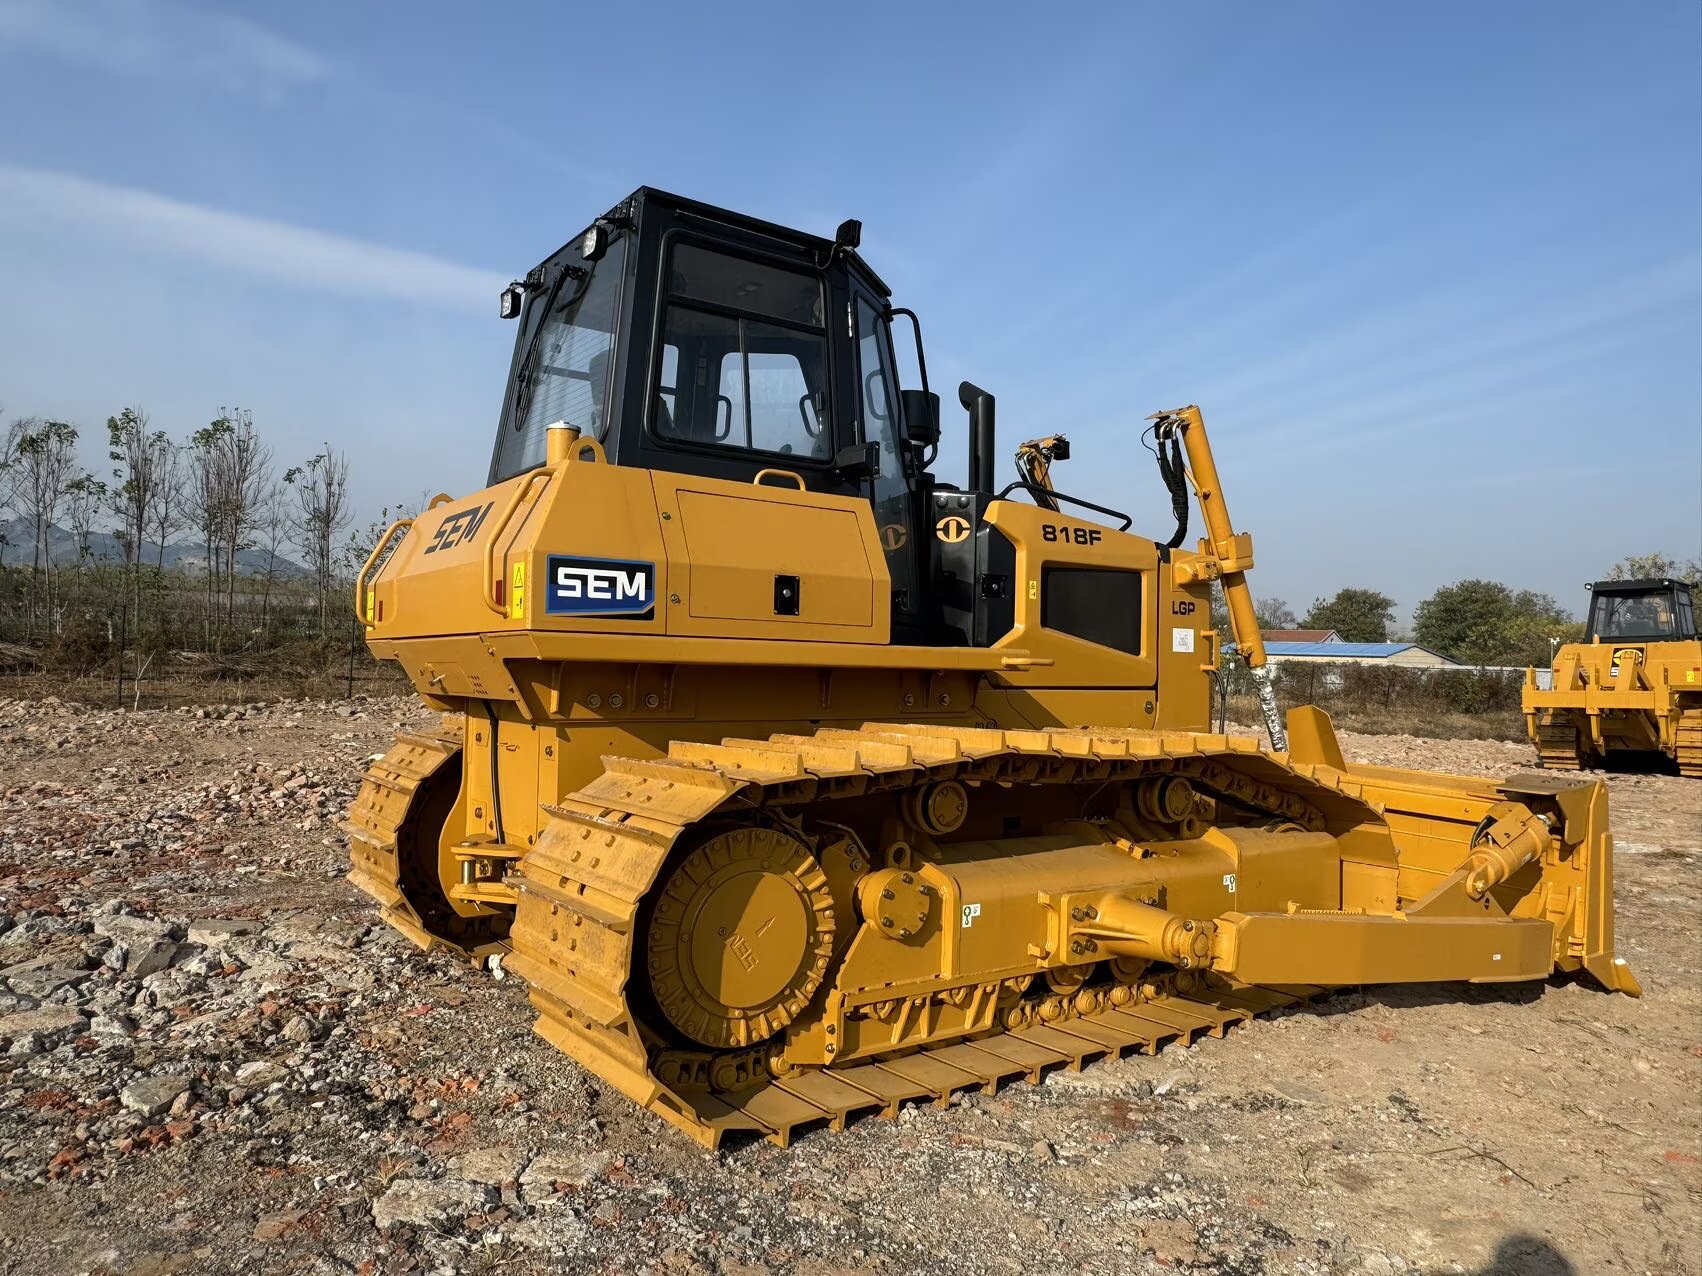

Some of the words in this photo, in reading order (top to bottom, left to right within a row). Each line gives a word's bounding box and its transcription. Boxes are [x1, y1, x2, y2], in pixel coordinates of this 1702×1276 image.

[424, 501, 495, 554] SEM
[1042, 524, 1102, 545] 818F
[557, 567, 646, 601] SEM
[1172, 600, 1195, 615] LGP
